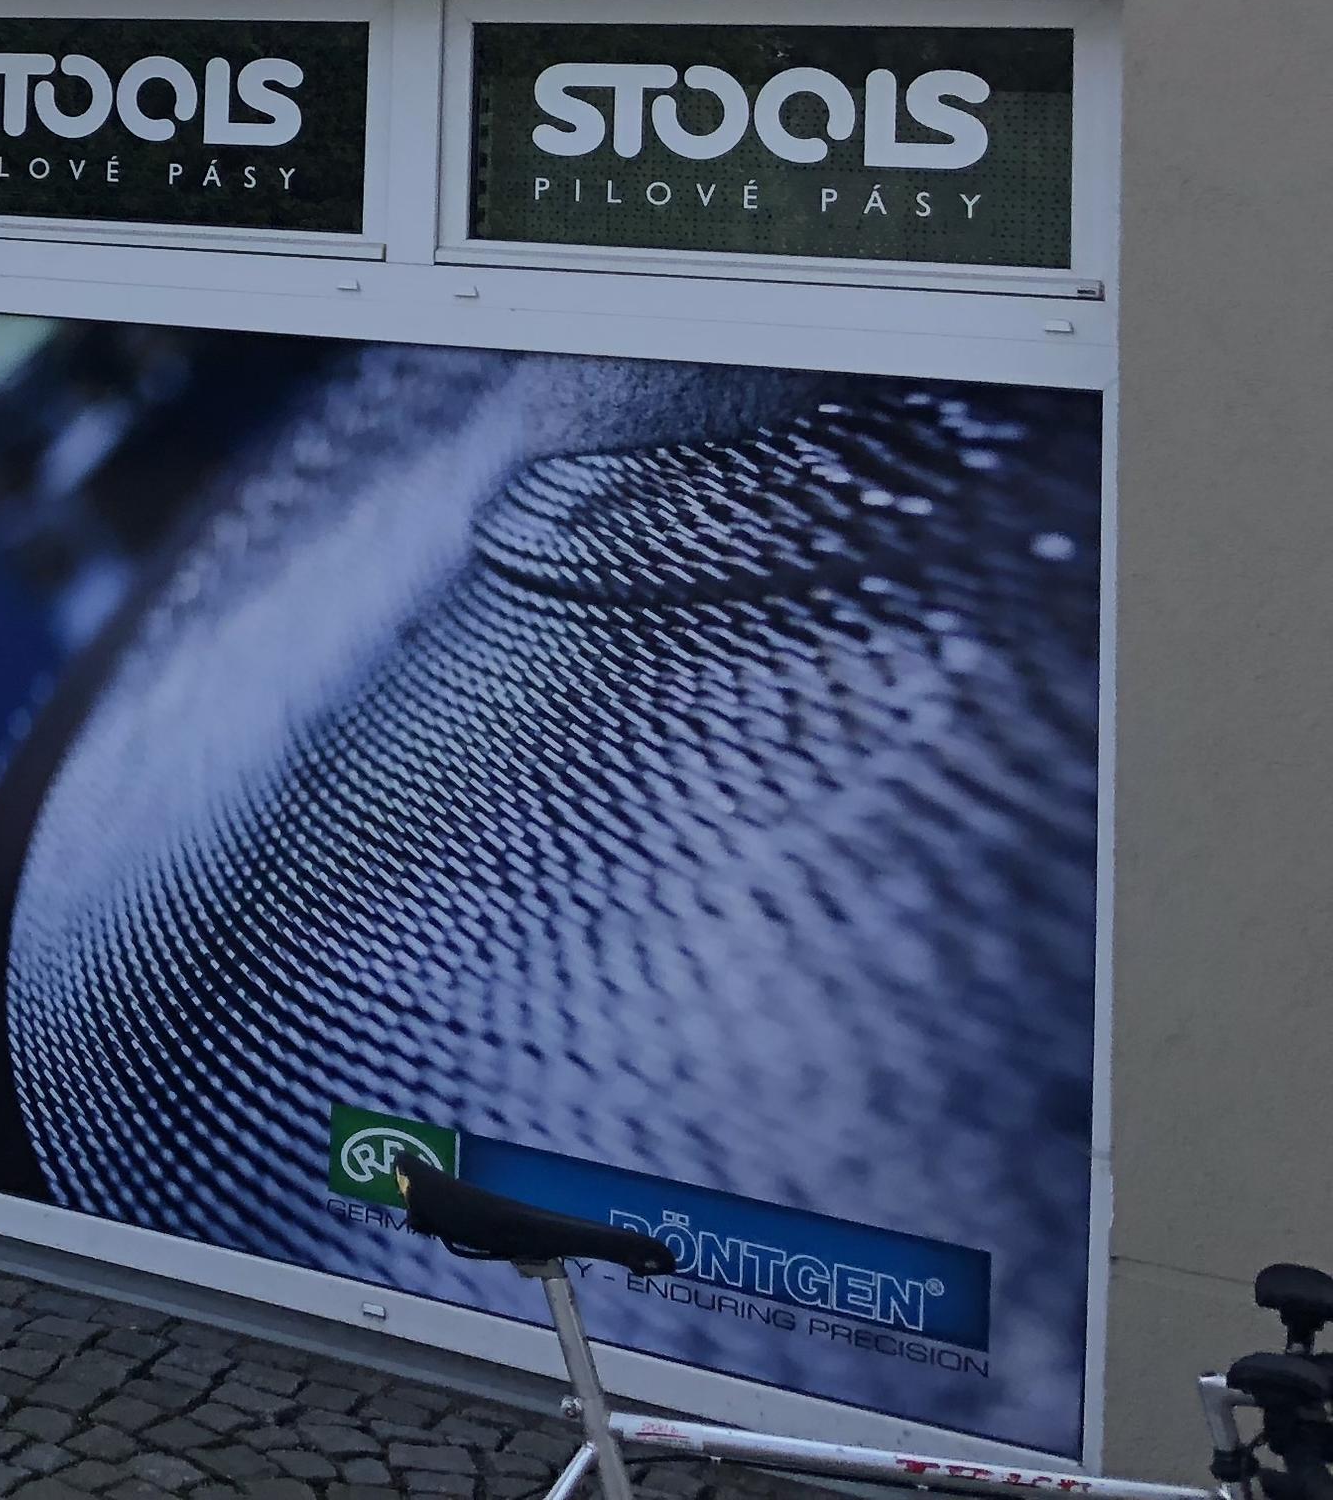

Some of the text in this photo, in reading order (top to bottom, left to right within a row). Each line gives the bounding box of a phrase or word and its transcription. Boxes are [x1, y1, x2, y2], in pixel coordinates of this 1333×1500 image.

[532, 62, 990, 170] STOOLS
[168, 159, 296, 191] PÁSY
[533, 178, 982, 219] PILOVÉ PÁSY
[627, 1274, 796, 1332] ENDURING
[808, 1317, 990, 1379] PRECISION
